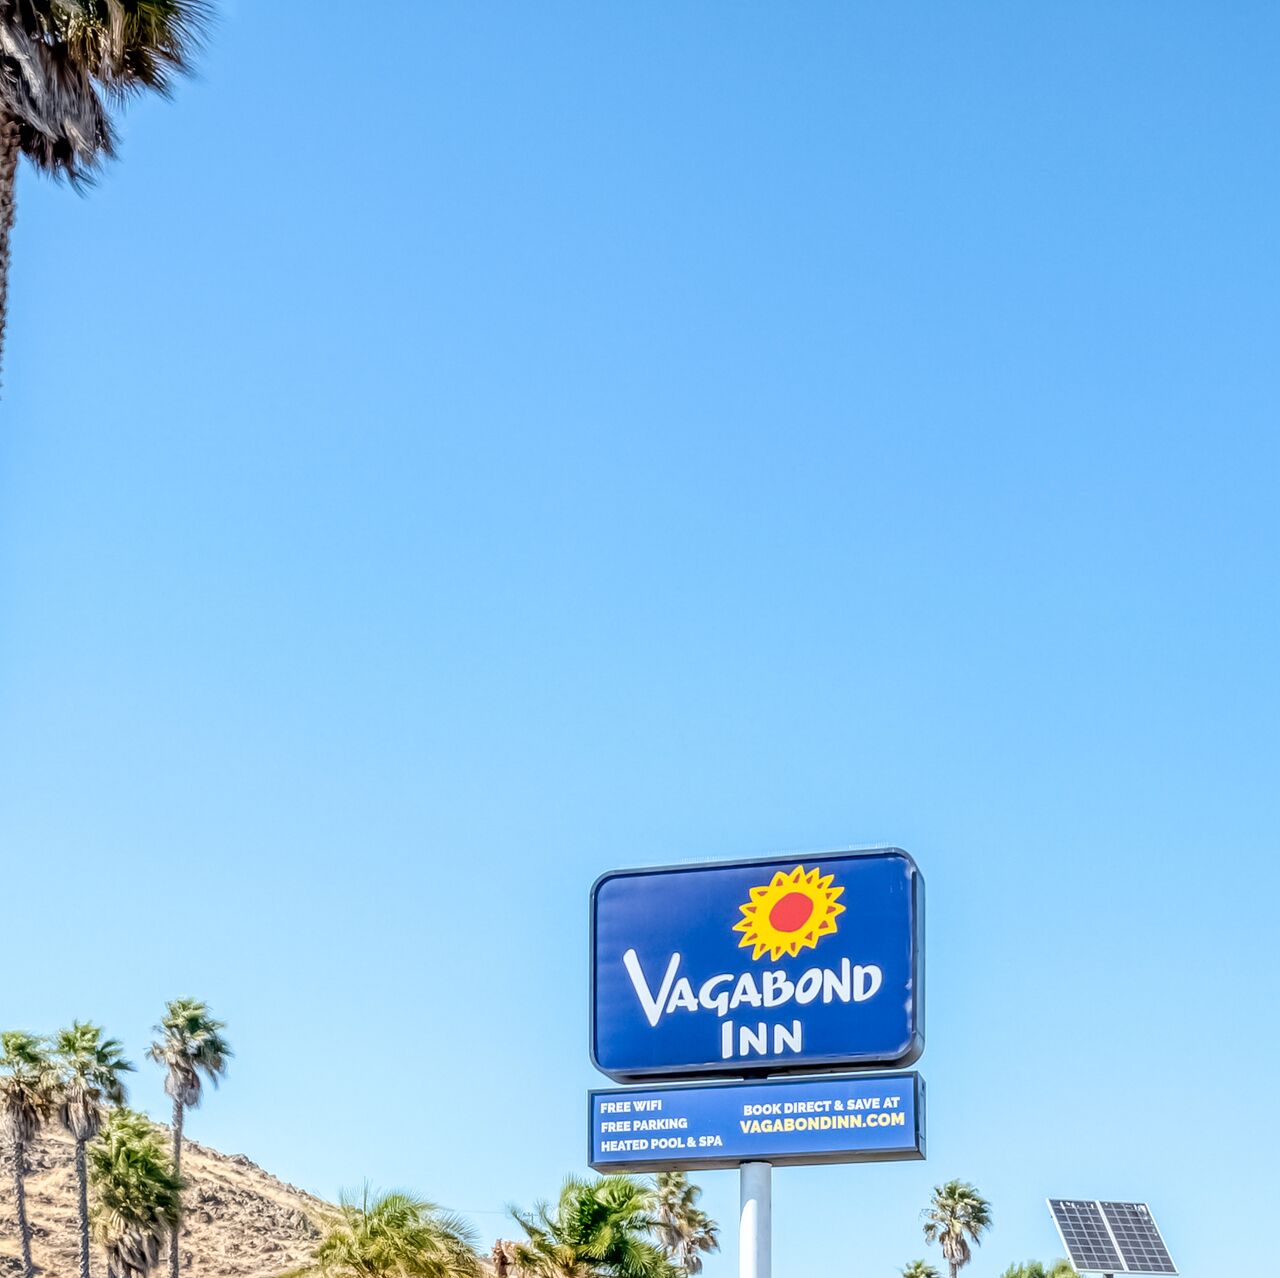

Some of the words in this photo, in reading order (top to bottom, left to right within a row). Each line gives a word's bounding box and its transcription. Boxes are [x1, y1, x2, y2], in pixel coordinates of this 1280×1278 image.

[721, 1019, 802, 1059] INN
[600, 1102, 631, 1114] FREE
[633, 1099, 662, 1112] WIFI
[743, 1103, 781, 1116] BOOK
[784, 1100, 832, 1114] DIRECT
[834, 1099, 844, 1111] &
[847, 1097, 880, 1110] SAVE
[882, 1096, 900, 1109] AT
[601, 1121, 631, 1133] FREE
[633, 1118, 688, 1131] PARKING
[740, 1112, 905, 1134] VAGABONDINN.COM
[601, 1139, 648, 1152] HEATED
[650, 1137, 686, 1149] POOL
[687, 1136, 697, 1147] &
[698, 1135, 723, 1147] SPA
